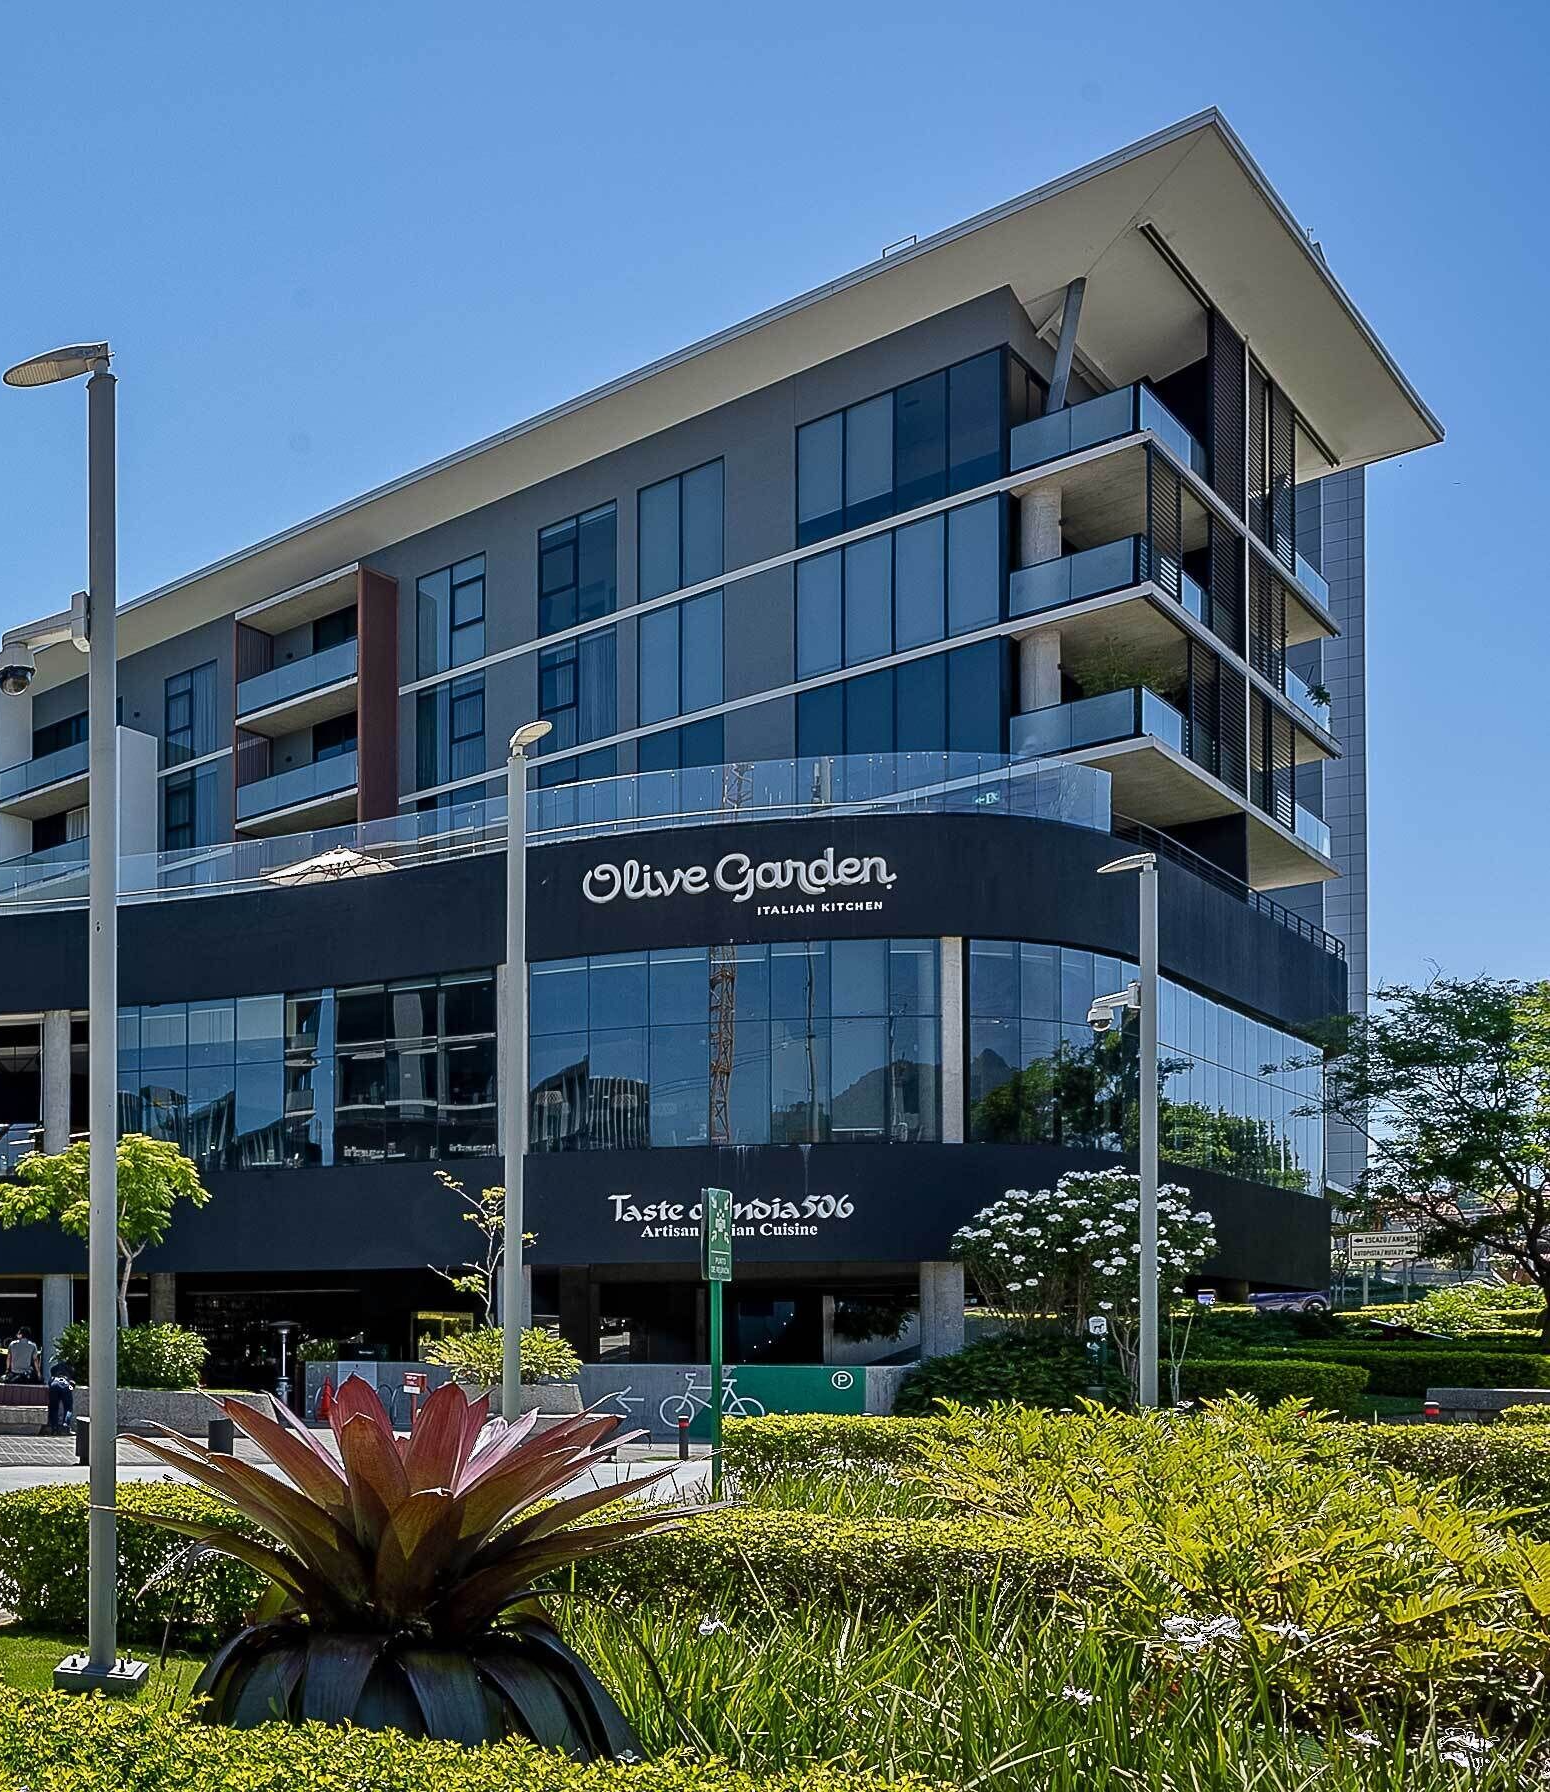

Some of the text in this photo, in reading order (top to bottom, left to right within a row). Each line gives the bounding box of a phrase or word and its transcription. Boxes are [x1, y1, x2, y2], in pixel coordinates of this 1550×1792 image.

[582, 847, 897, 904] Olive Garden
[757, 901, 884, 917] ITALIAN KITCHEN
[607, 1193, 685, 1222] Taste
[688, 1203, 703, 1221] o
[731, 1198, 800, 1221] ndia
[640, 1225, 700, 1238] Artisan
[759, 1222, 818, 1237] Cuisine
